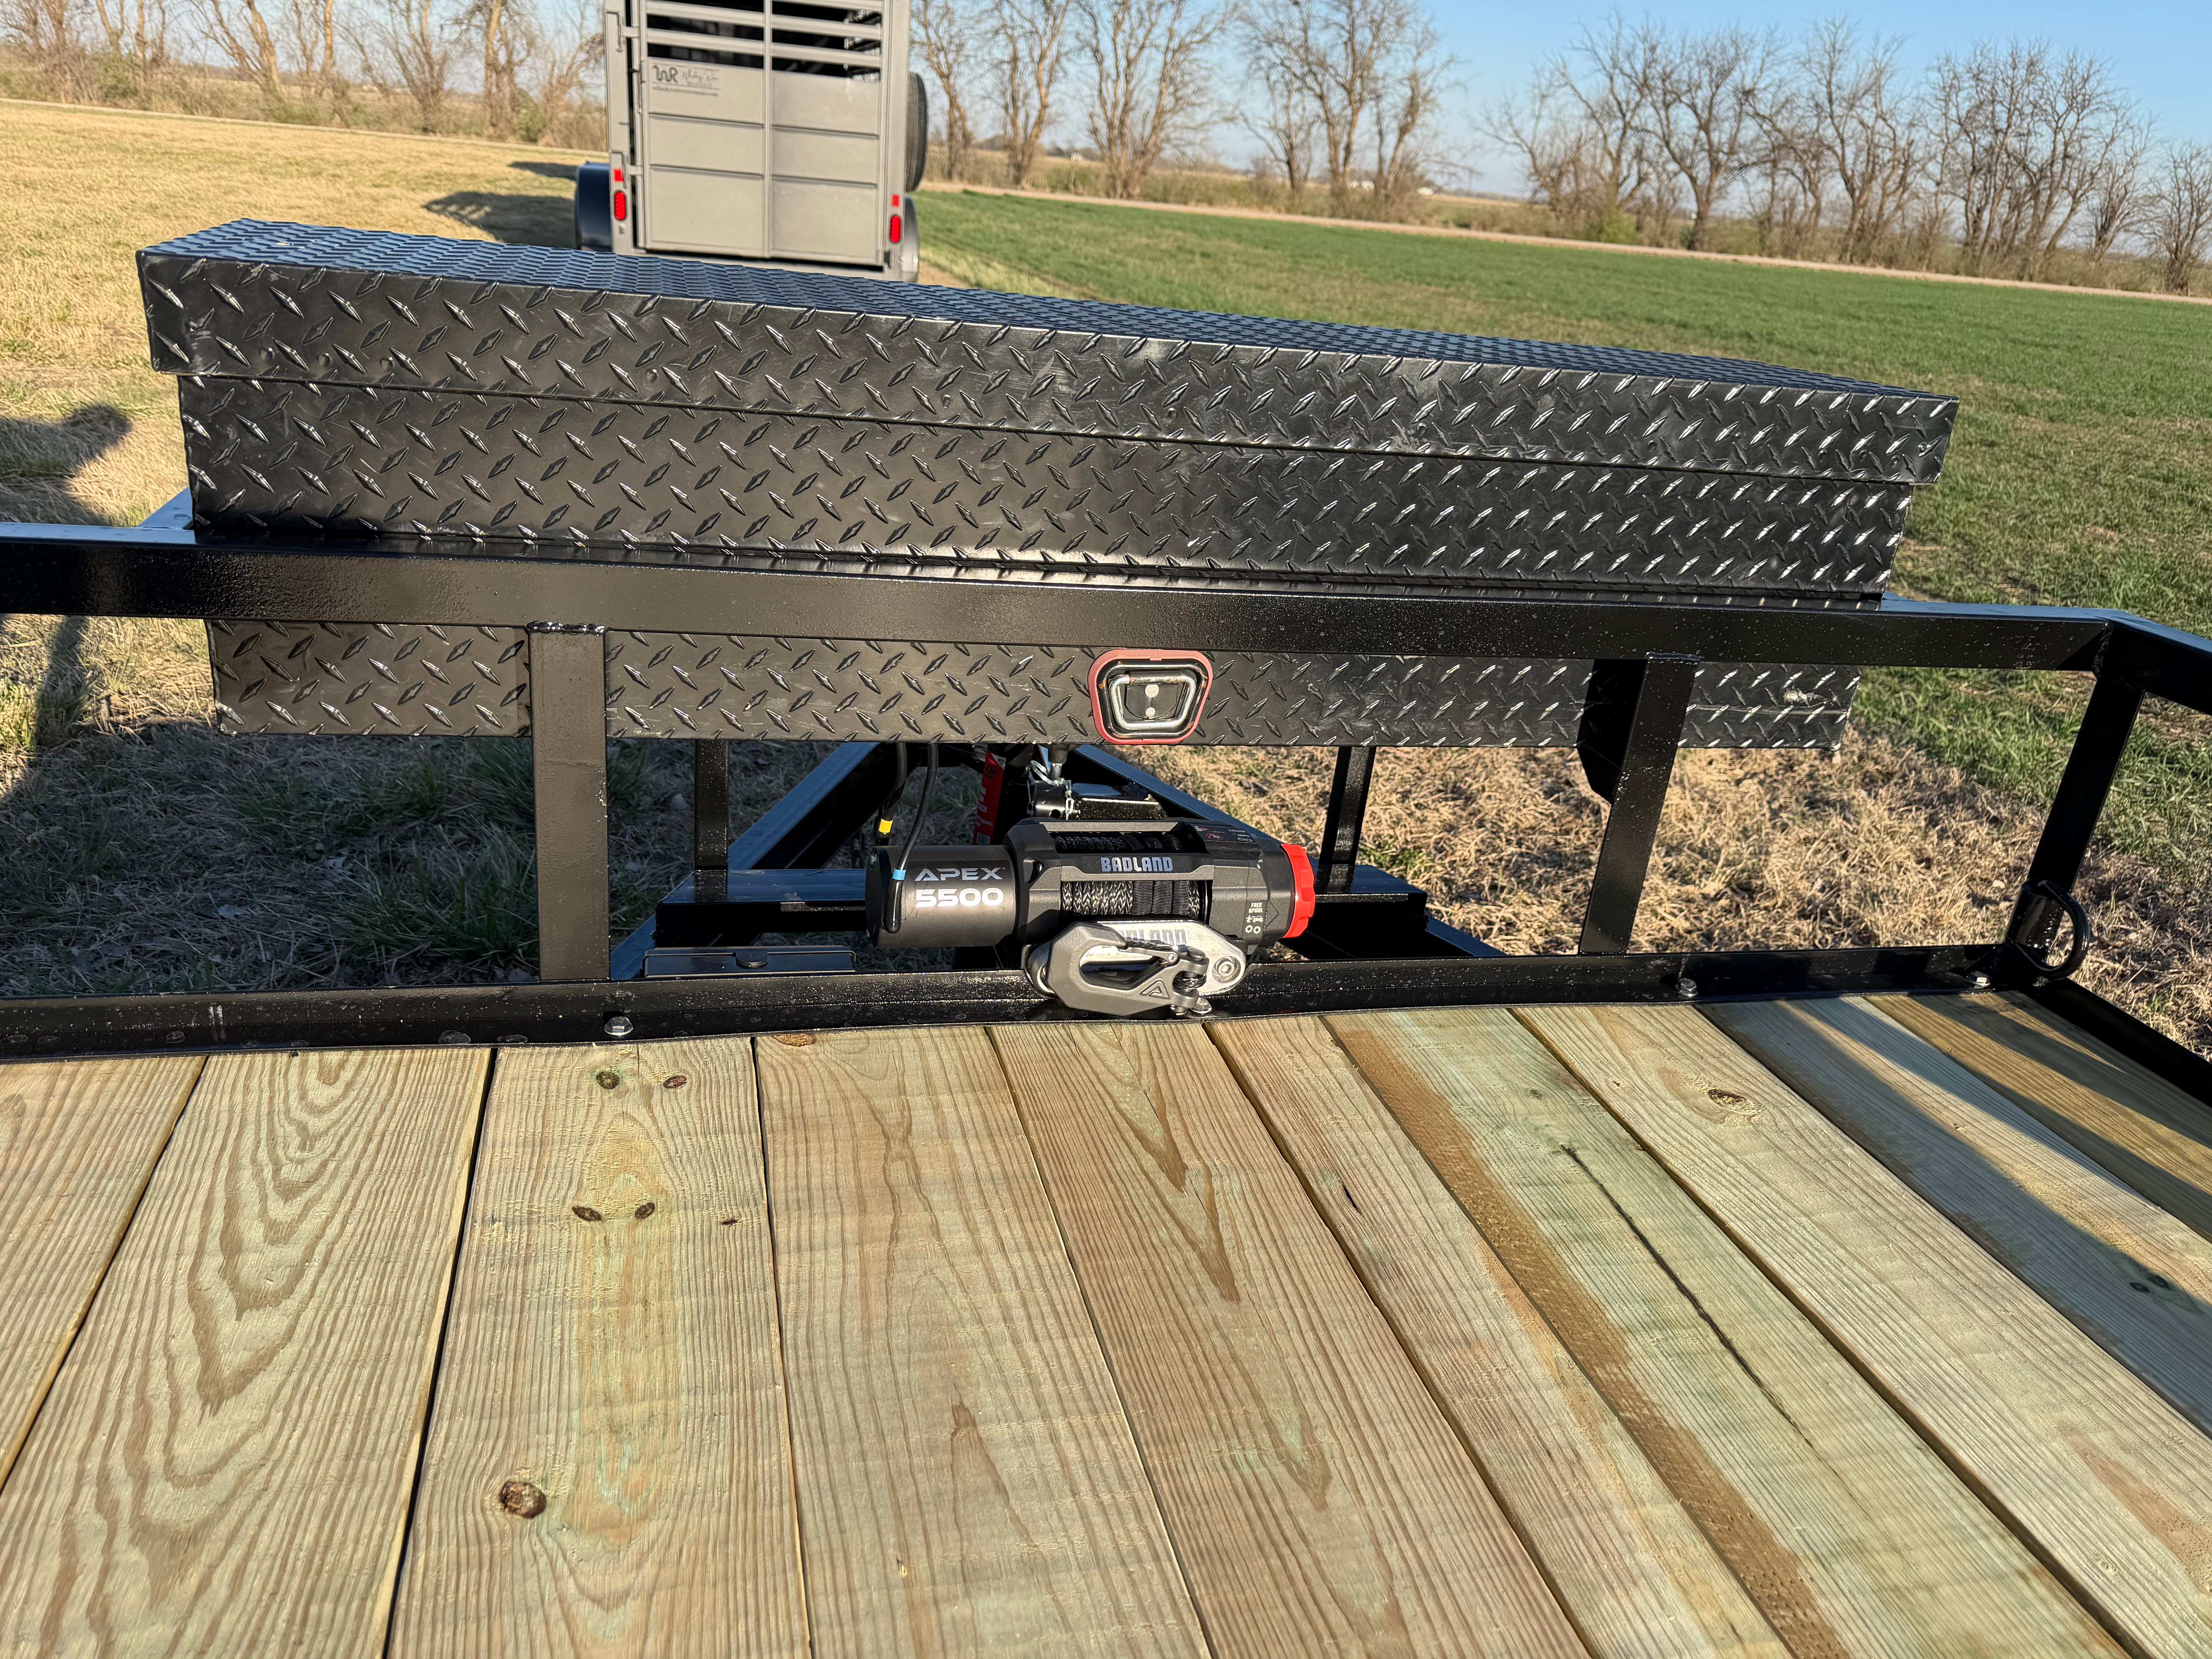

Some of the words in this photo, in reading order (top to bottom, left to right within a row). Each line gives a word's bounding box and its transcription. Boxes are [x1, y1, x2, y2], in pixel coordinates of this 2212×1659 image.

[1100, 857, 1173, 871] BADLAND
[914, 867, 1003, 881] APEX
[915, 888, 1004, 908] 5500
